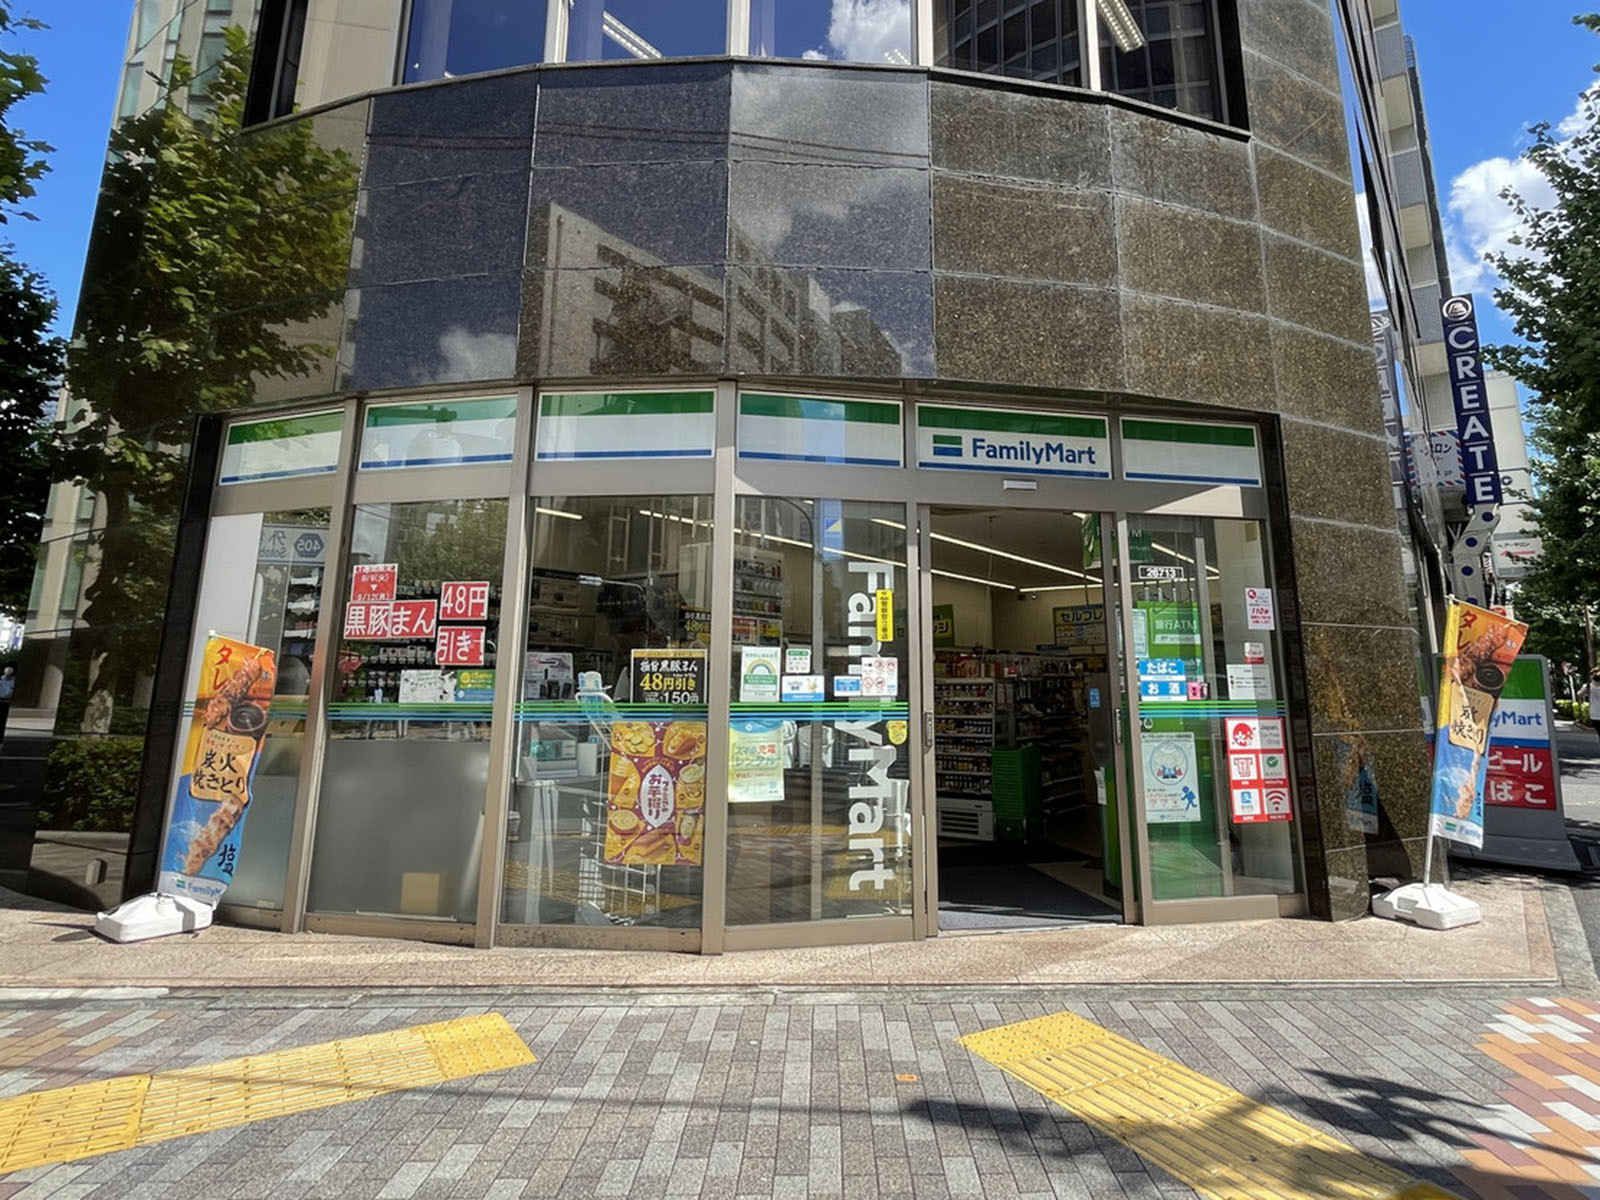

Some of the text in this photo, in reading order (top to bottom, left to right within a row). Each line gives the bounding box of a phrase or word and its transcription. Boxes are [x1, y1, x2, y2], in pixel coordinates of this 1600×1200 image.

[1448, 326, 1495, 502] CREATE
[972, 437, 1096, 465] FamilyMart
[1146, 567, 1176, 578] 26713
[441, 585, 487, 617] 48円
[345, 604, 435, 636] 黒豚まん
[1456, 609, 1479, 651] タレ
[212, 643, 234, 691] タレ
[1147, 661, 1178, 674] たばこ
[639, 672, 697, 691] 48円引き
[201, 749, 238, 774] 炭火
[192, 769, 245, 795] 焼きとり
[1489, 780, 1547, 805] ばこ
